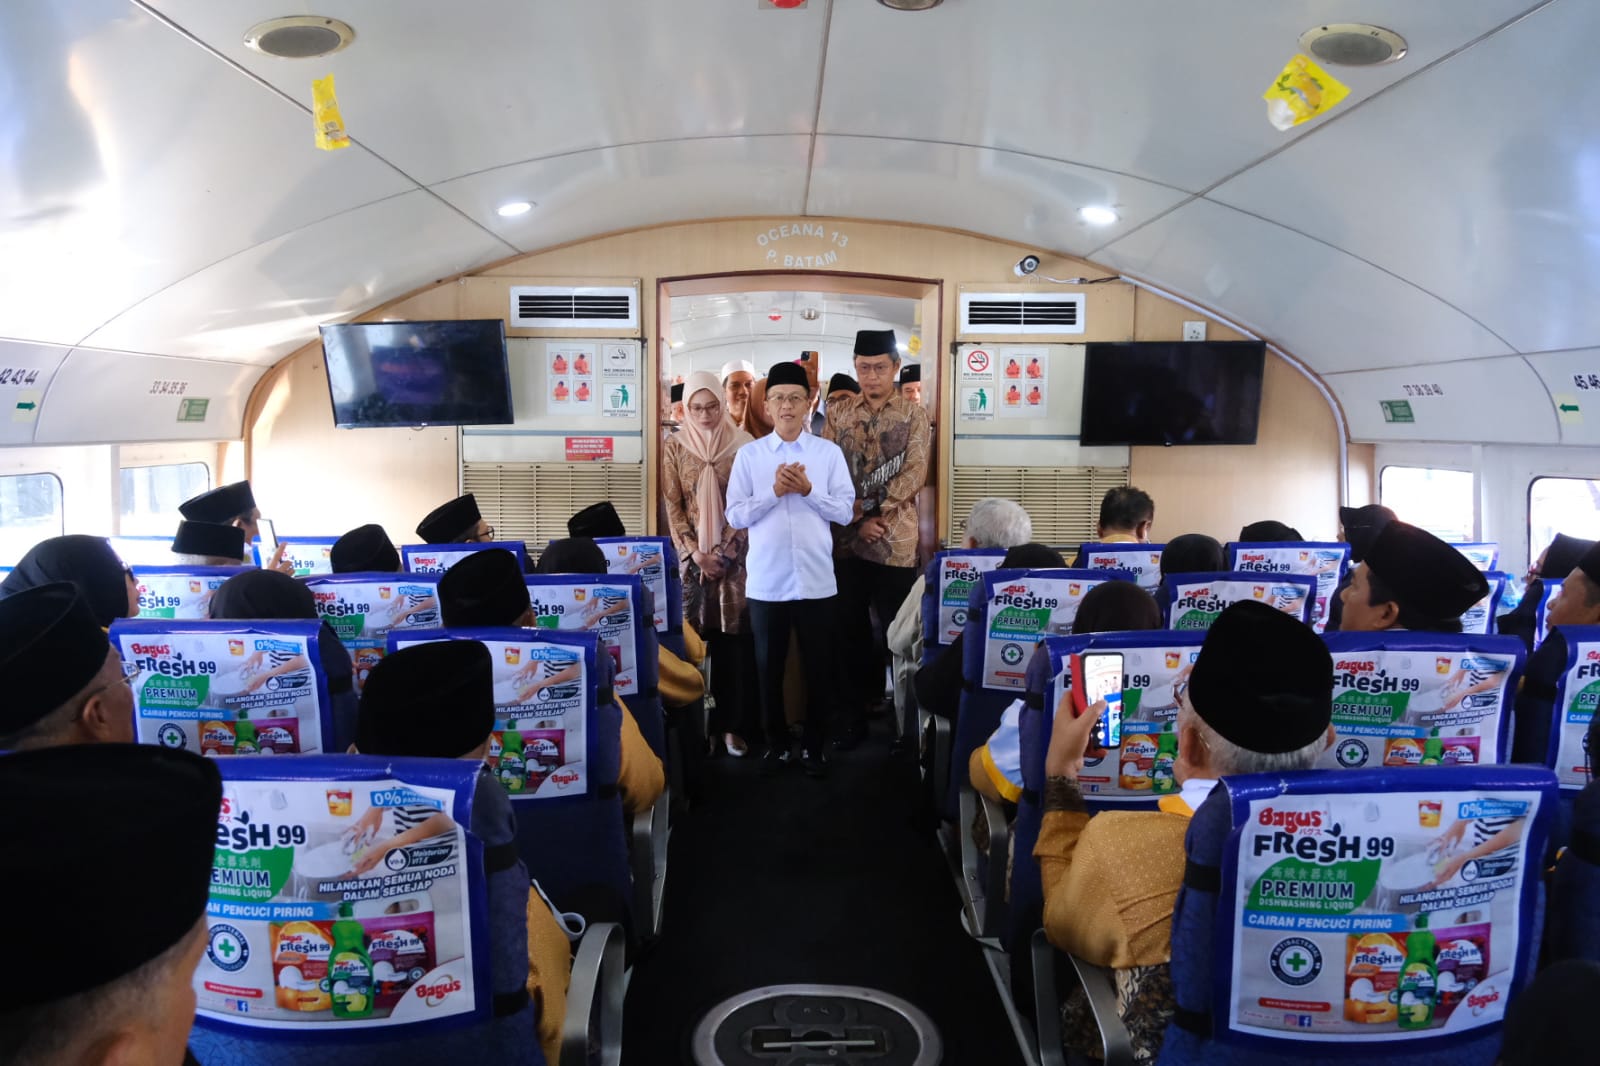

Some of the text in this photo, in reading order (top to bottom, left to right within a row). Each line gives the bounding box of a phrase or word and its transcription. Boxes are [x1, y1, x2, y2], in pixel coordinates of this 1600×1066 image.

[757, 223, 849, 248] OCEANA 13
[766, 249, 838, 268] P. BATAM
[1574, 375, 1589, 390] 45
[304, 560, 315, 568] 99
[1240, 562, 1290, 572] FResH 99
[945, 569, 983, 582] FResH
[138, 595, 181, 609] esH 99
[316, 602, 370, 616] ResH 99
[551, 604, 565, 614] 99
[995, 594, 1058, 609] FResH 99
[1178, 596, 1226, 612] FResH
[997, 616, 1039, 626] PREMIUM
[131, 643, 170, 658] Bagus
[256, 641, 275, 650] 0%
[532, 649, 550, 660] 0%
[135, 657, 216, 677] FResH 99
[1335, 660, 1375, 675] Bagus
[1132, 674, 1151, 688] 99
[1400, 678, 1420, 691] 99
[145, 687, 197, 699] PREMIUM
[240, 701, 265, 709] DALAM
[495, 705, 535, 713] HILANGKAN
[536, 702, 559, 711] SEMUA
[1333, 703, 1392, 717] PREMIUM
[142, 708, 168, 716] CAIRAN
[199, 711, 224, 719] PIRING
[535, 708, 565, 718] SEKEJAP
[374, 791, 401, 806] 0%
[1460, 803, 1482, 818] 0%
[1258, 807, 1322, 834] Bagus
[215, 823, 306, 851] esH 99
[1253, 832, 1395, 863] FResH 99
[212, 868, 271, 888] EMIUM
[319, 866, 456, 893] HILANGKAN SEMUA NODA
[243, 888, 273, 899] LIQUID
[343, 880, 432, 901] DALAM SEKEJAP
[1261, 880, 1354, 899] PREMIUM
[1399, 889, 1456, 904] HILANGKAN
[1457, 883, 1489, 897] SEMUA
[1259, 898, 1354, 911] DISHWASHING LIQUID
[1420, 891, 1495, 912] DALAM SEKEJAP
[222, 903, 271, 917] PENCUCI
[274, 906, 314, 918] PIRING
[1248, 914, 1393, 930] CAIRAN PENCUCI PIRING
[280, 942, 318, 954] FResH
[1354, 954, 1392, 965] FResH
[416, 980, 461, 999] Bagus
[1467, 992, 1499, 1009] Bagus
